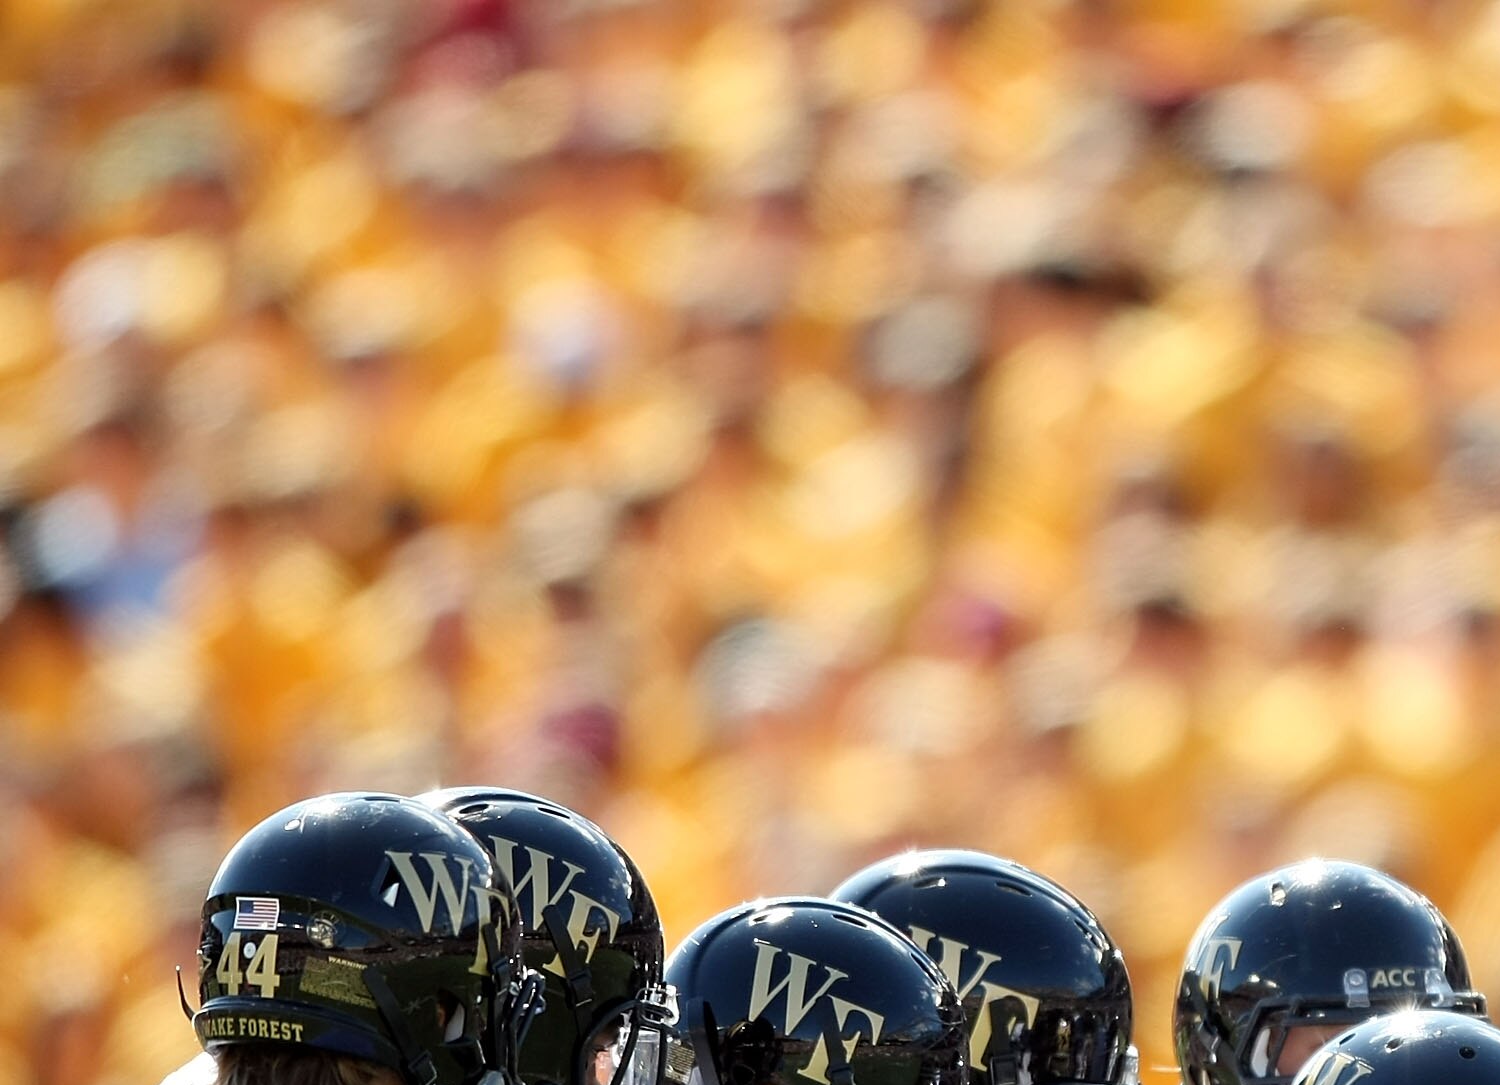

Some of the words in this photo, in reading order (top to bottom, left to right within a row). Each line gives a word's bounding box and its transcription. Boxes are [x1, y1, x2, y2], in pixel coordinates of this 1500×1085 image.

[385, 850, 510, 976] WF
[488, 835, 620, 978] WF
[216, 932, 280, 998] 44
[1372, 969, 1416, 987] ACC
[204, 1017, 234, 1037] WAKE
[239, 1018, 303, 1042] FOREST
[748, 943, 884, 1085] WF
